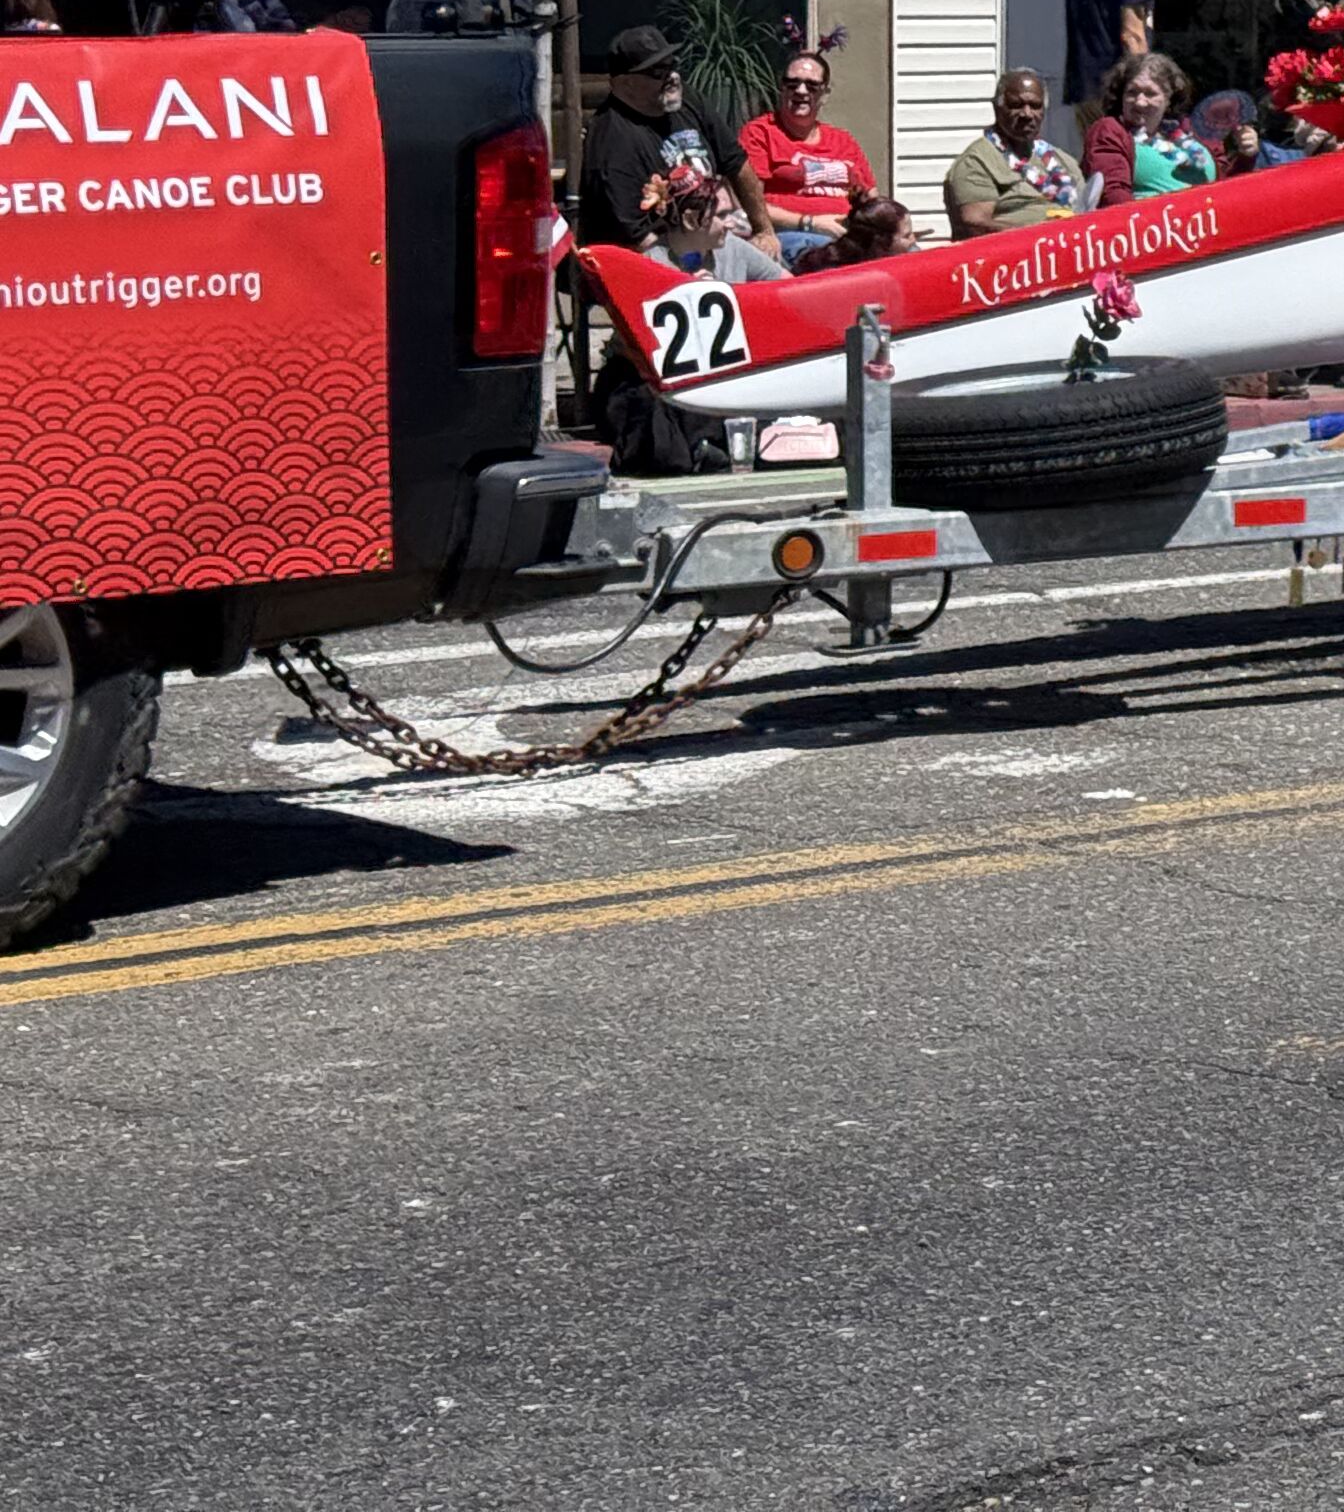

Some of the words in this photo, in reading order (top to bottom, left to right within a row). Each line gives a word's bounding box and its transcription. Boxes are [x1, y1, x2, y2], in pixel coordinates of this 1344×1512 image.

[77, 174, 216, 213] CANOE
[225, 171, 325, 206] CLUB
[652, 290, 747, 378] 22
